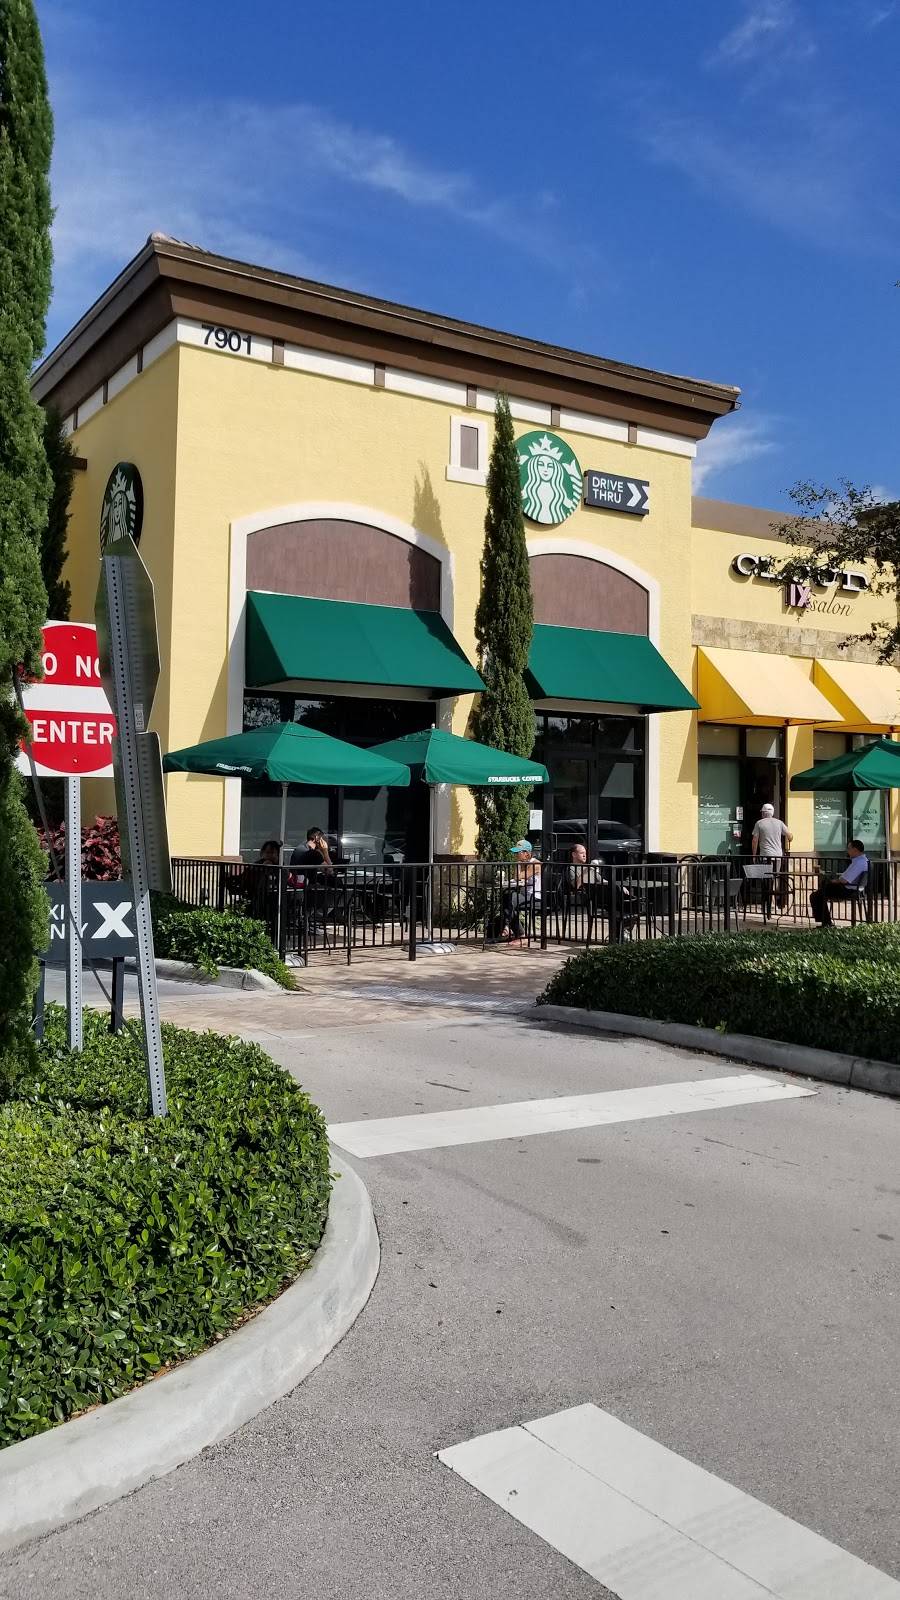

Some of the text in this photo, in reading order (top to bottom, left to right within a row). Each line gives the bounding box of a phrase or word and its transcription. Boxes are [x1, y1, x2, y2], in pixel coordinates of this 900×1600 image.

[201, 323, 251, 355] 7901
[592, 476, 624, 493] DRIVE
[592, 488, 622, 504] THRU
[810, 590, 853, 616] salon
[33, 719, 114, 745] ENTER
